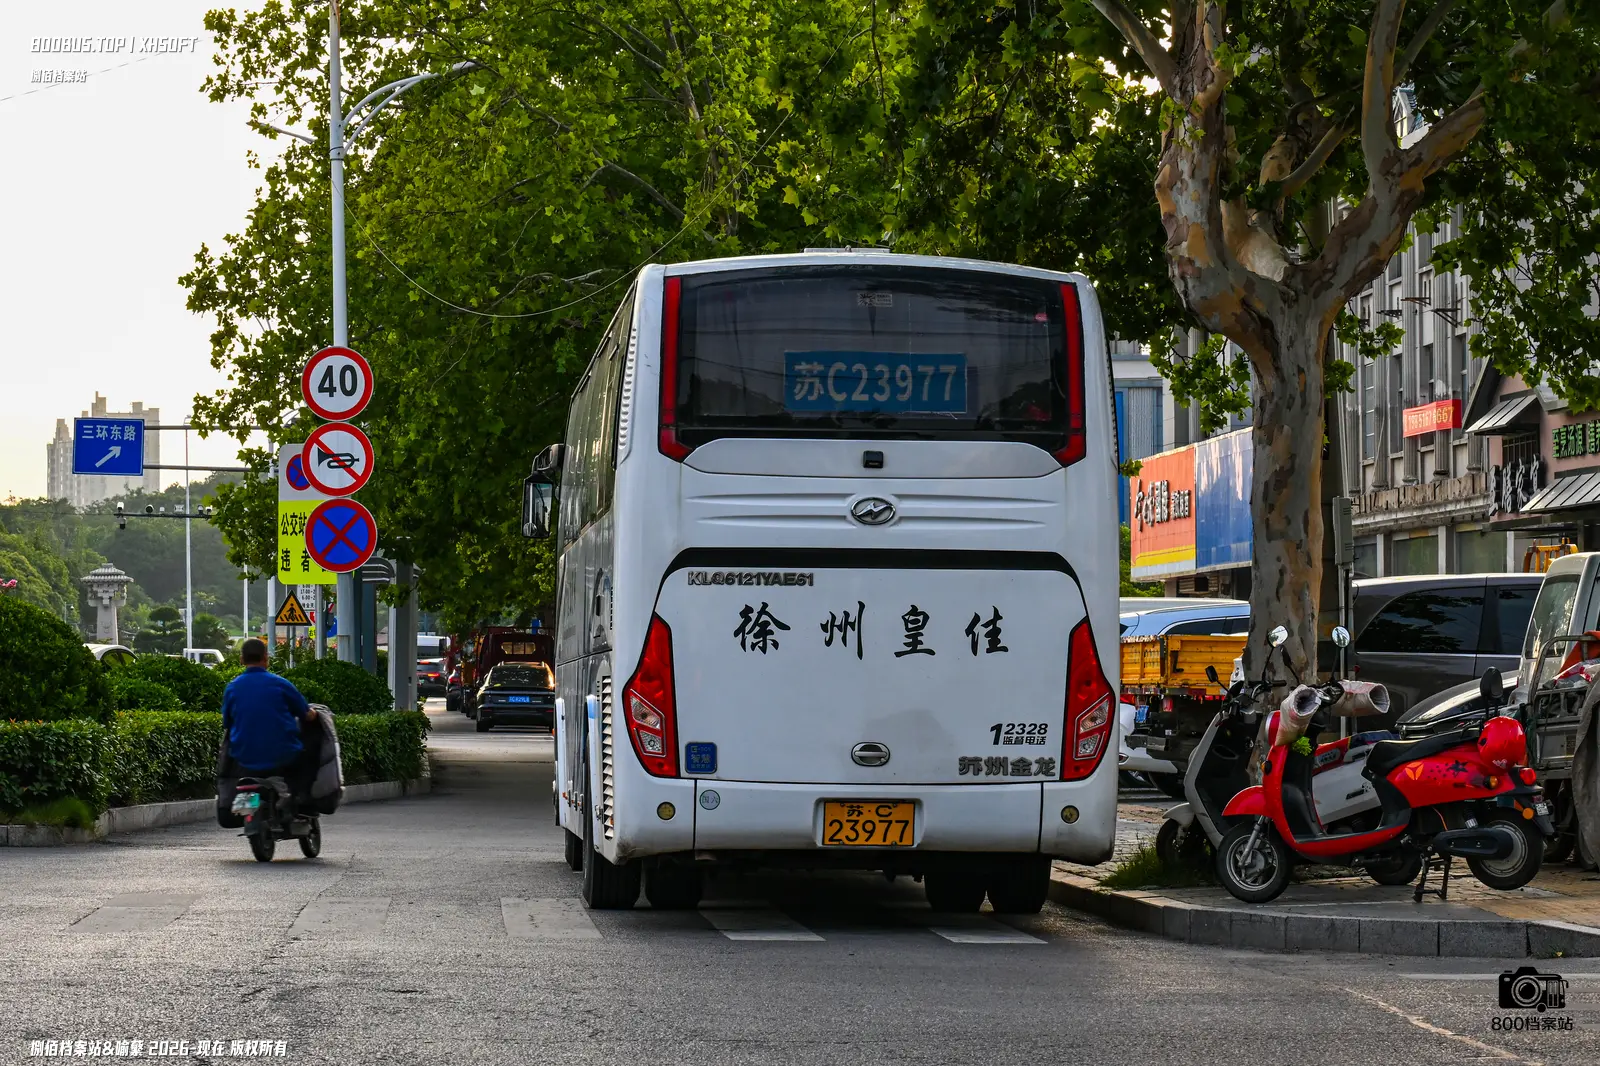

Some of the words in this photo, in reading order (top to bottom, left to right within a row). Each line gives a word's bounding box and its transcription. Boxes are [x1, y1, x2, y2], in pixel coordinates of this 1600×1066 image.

[318, 364, 358, 398] 40
[793, 361, 957, 401] 苏C23977
[82, 424, 136, 441] 三环东路
[688, 570, 815, 587] KLQ6121YAE61
[733, 600, 1010, 661] 徐州皇佳
[989, 722, 1049, 746] 12328
[1002, 735, 1047, 746] 监督电话
[958, 755, 1056, 777] 苏州金龙
[828, 818, 910, 843] 23977
